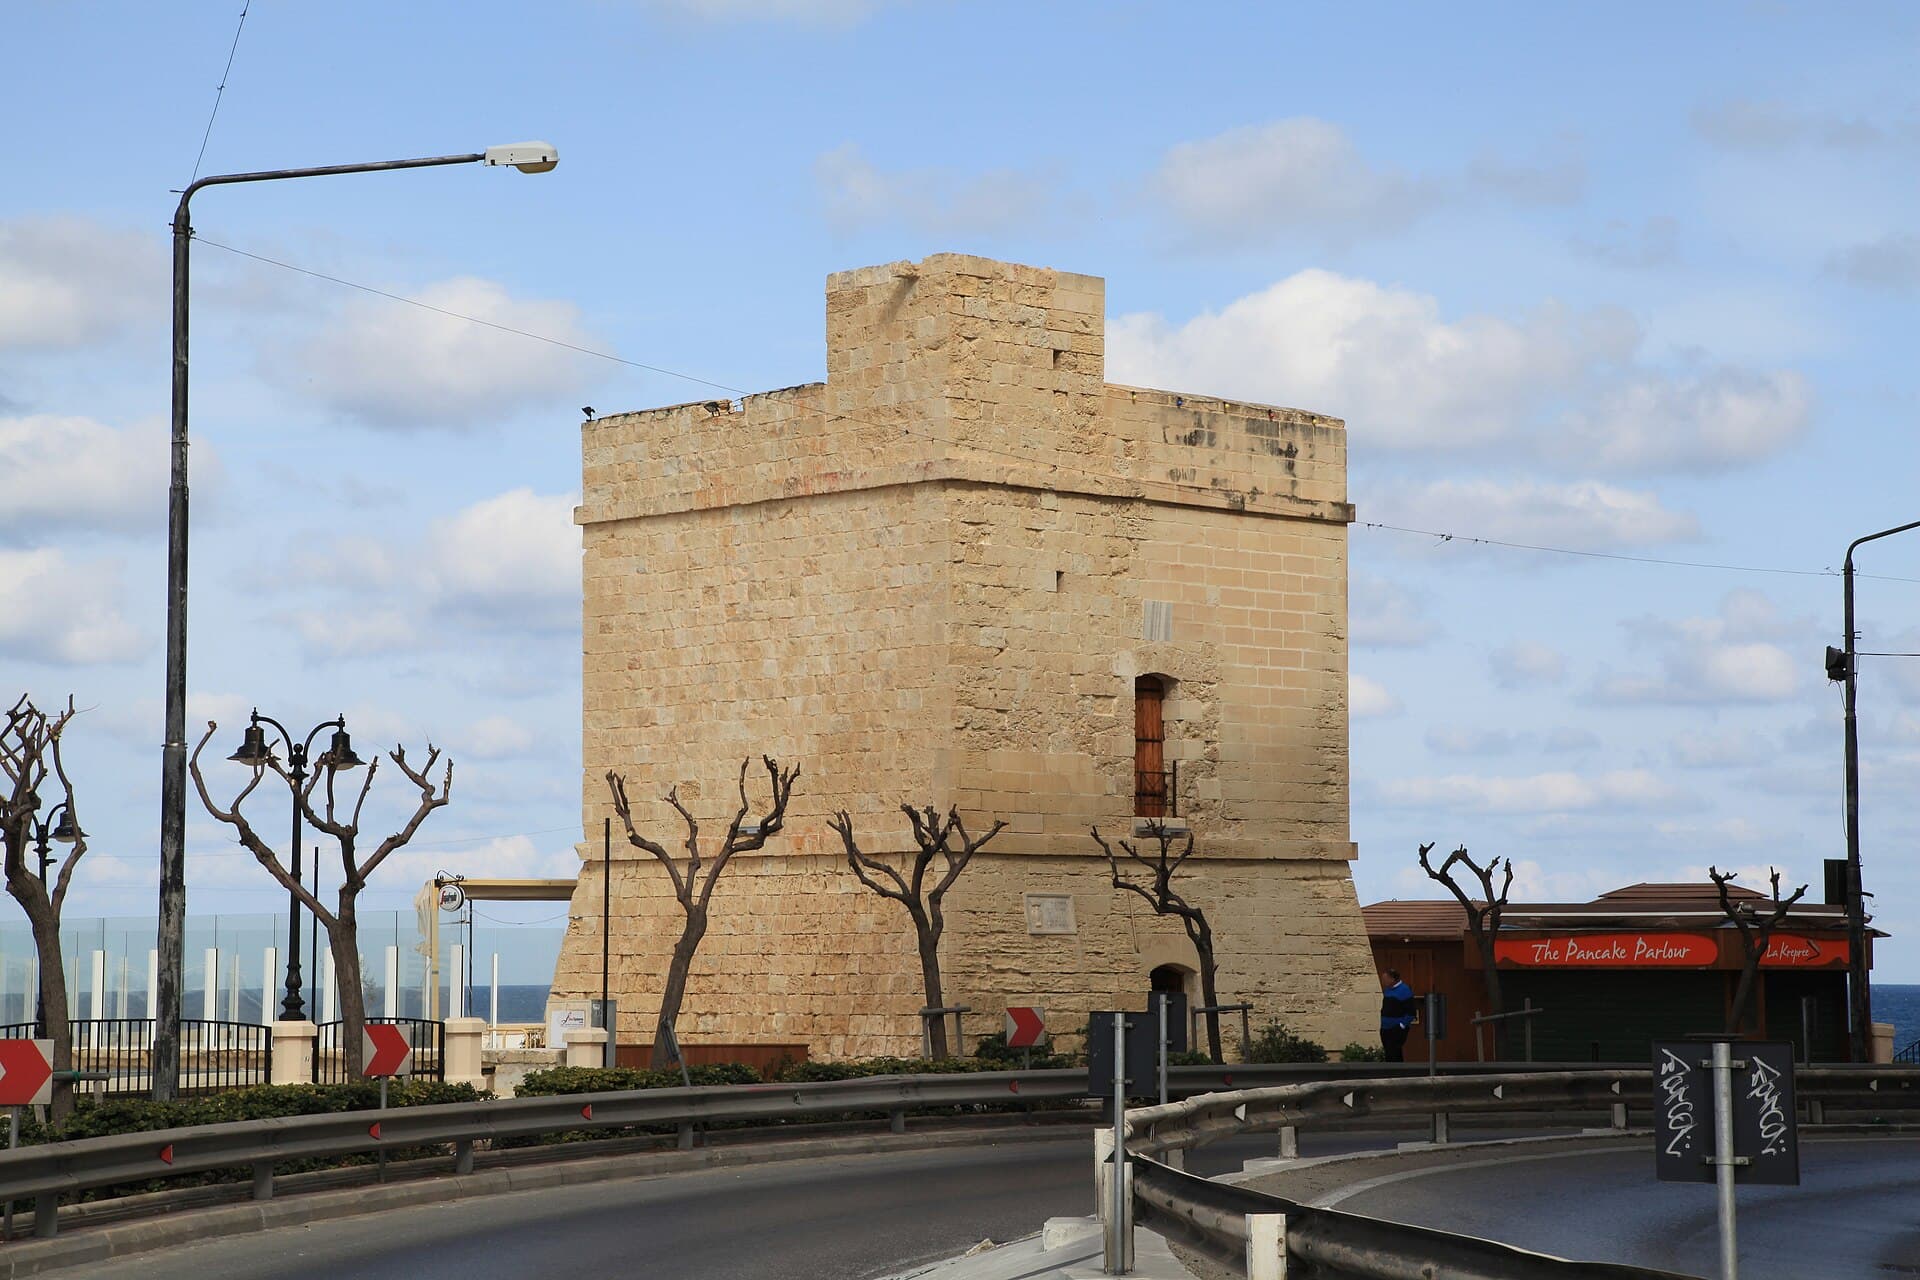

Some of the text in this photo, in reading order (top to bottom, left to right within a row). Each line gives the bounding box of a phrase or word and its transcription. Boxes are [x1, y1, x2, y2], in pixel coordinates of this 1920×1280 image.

[1531, 937, 1691, 963] The Pancake Parlour
[1766, 943, 1778, 958] La
